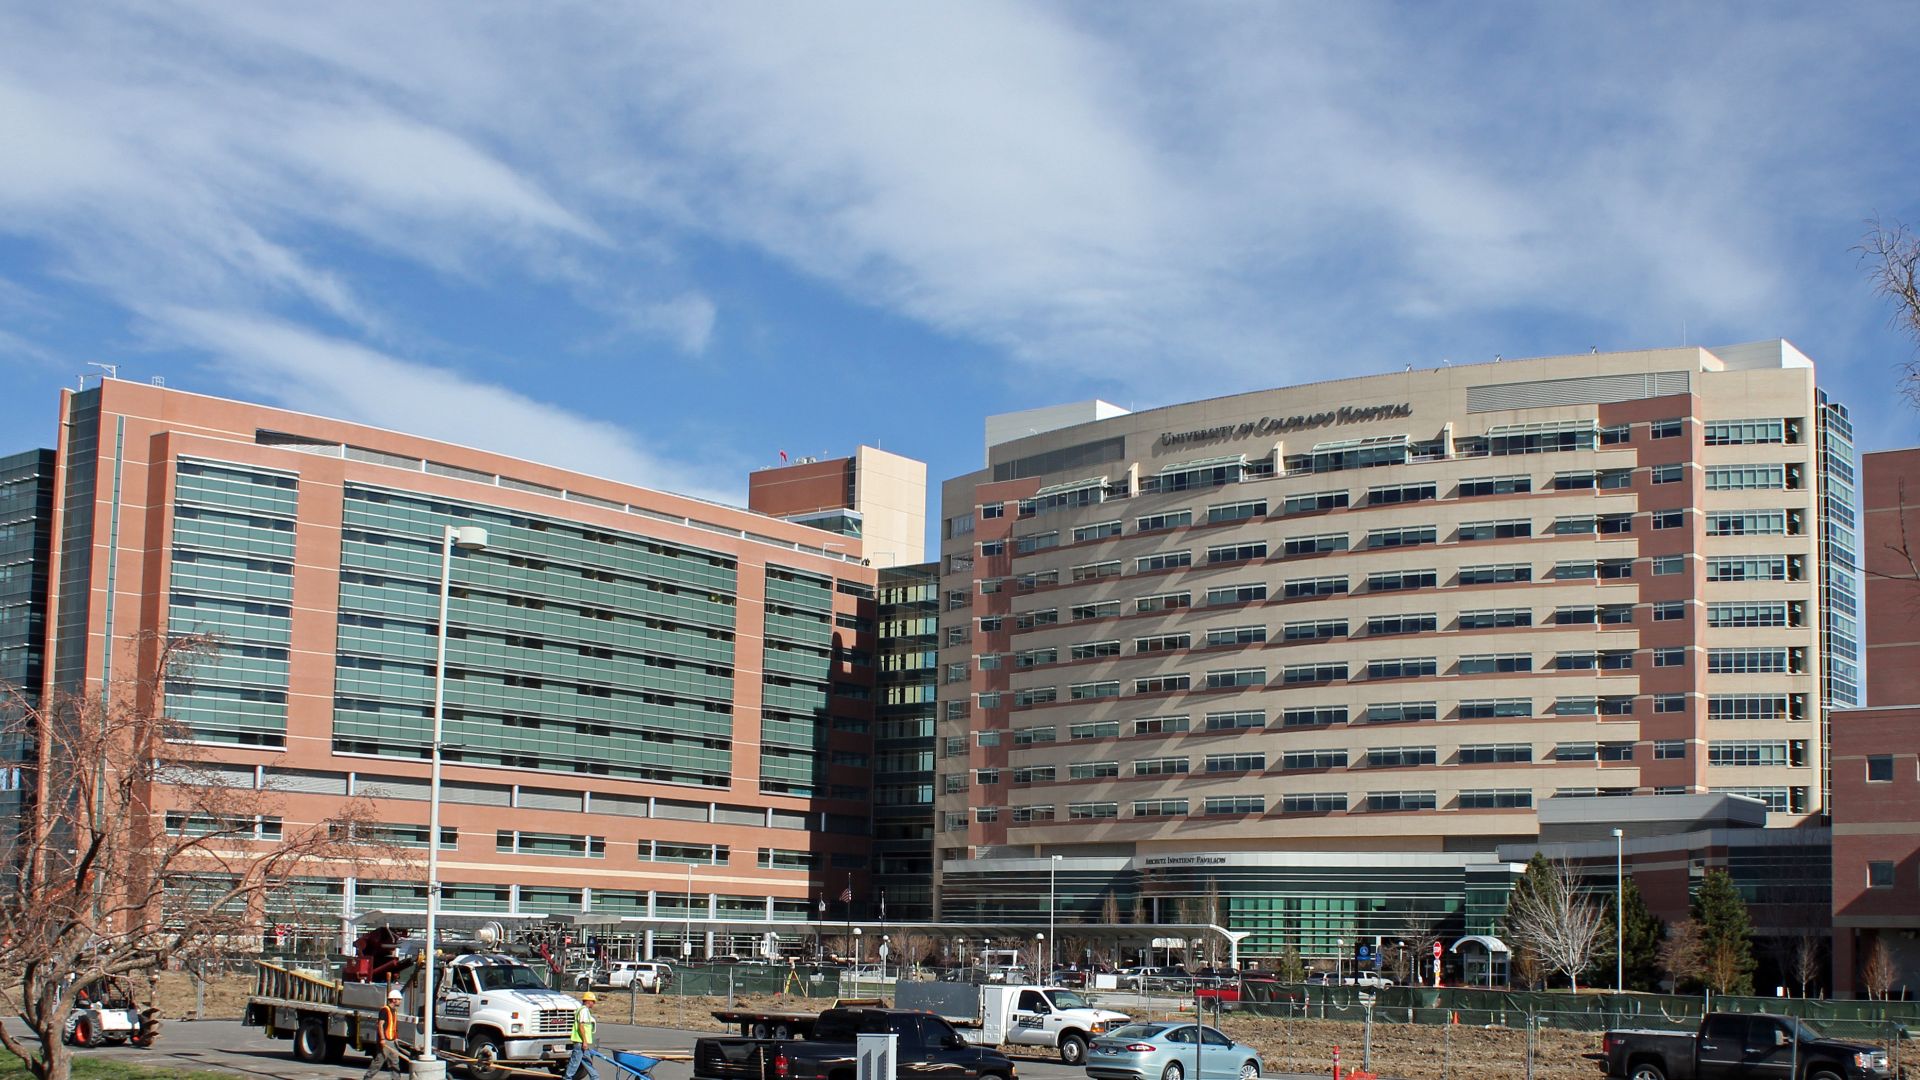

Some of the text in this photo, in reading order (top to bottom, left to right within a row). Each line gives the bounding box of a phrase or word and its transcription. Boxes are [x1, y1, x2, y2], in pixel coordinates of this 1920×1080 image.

[1161, 425, 1235, 447] UNIVERSITY
[1259, 411, 1335, 433] COLORADO
[1337, 402, 1411, 423] HOSPITAL
[1167, 856, 1195, 864] INPATIENT
